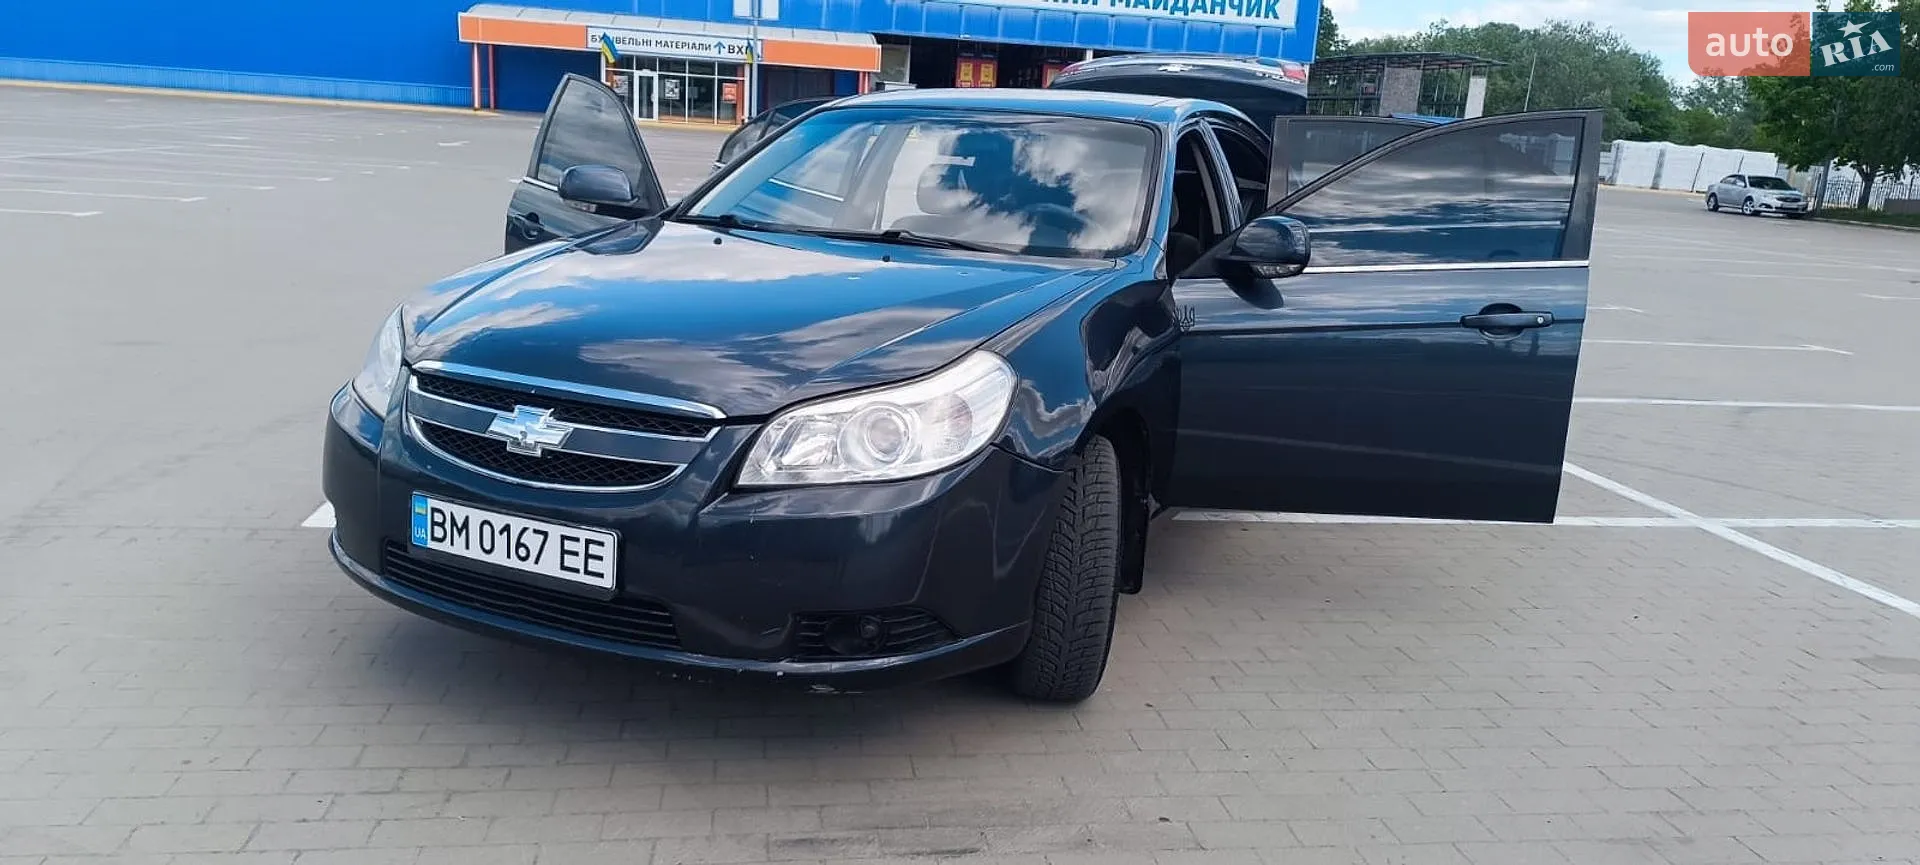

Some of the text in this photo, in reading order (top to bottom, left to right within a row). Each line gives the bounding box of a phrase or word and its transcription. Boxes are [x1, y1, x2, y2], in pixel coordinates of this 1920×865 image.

[591, 34, 760, 58] БУІВЕЛЬНІ МАТЕРІАЛИ ВХІ
[414, 526, 427, 540] UA
[430, 507, 606, 579] BM 0167 EE
